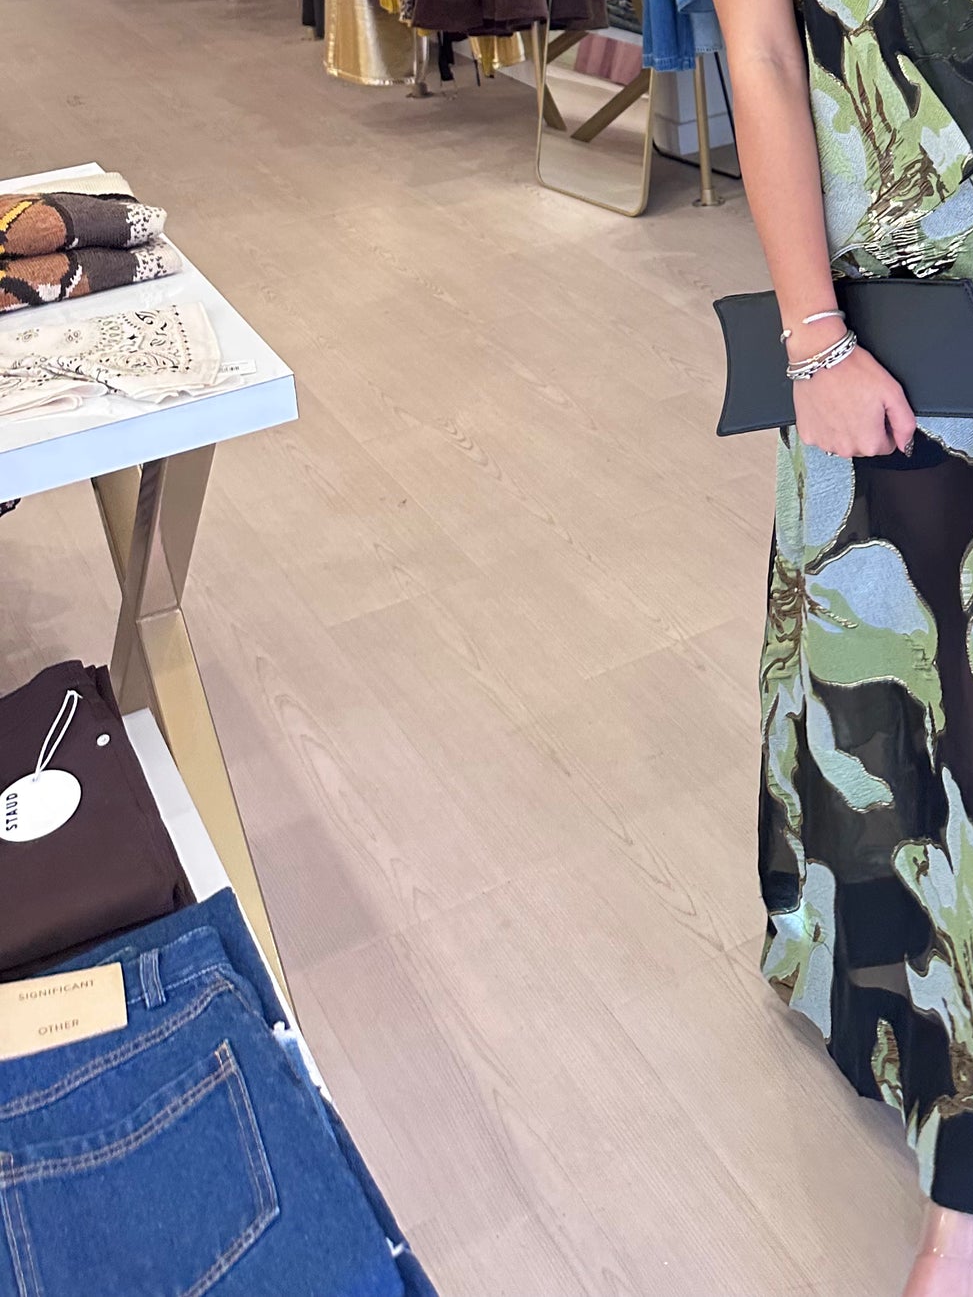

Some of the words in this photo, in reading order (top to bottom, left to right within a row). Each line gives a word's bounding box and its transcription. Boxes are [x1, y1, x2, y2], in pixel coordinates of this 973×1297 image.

[6, 793, 18, 831] STAUD
[19, 980, 94, 1001] SIGNIFICANT
[38, 1019, 79, 1035] OTHER
